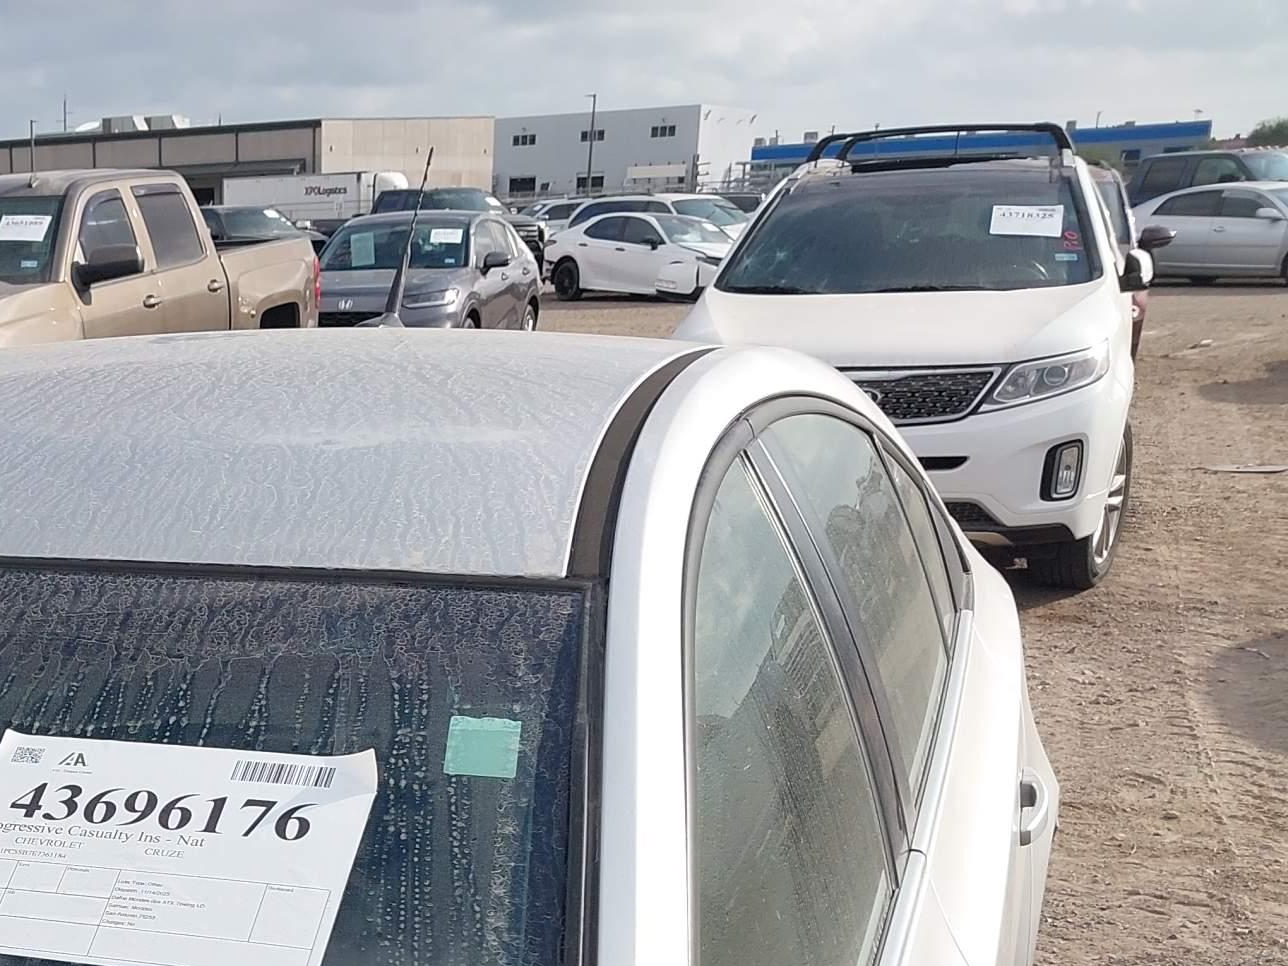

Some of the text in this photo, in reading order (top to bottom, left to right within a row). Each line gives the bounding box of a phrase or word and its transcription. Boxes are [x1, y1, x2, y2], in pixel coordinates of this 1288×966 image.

[9, 782, 320, 841] 43696176
[14, 836, 85, 849] CHEVROLET
[144, 848, 185, 858] CRUZE
[67, 825, 134, 843] Casualty
[137, 831, 161, 844] Ins
[177, 834, 207, 848] Nat
